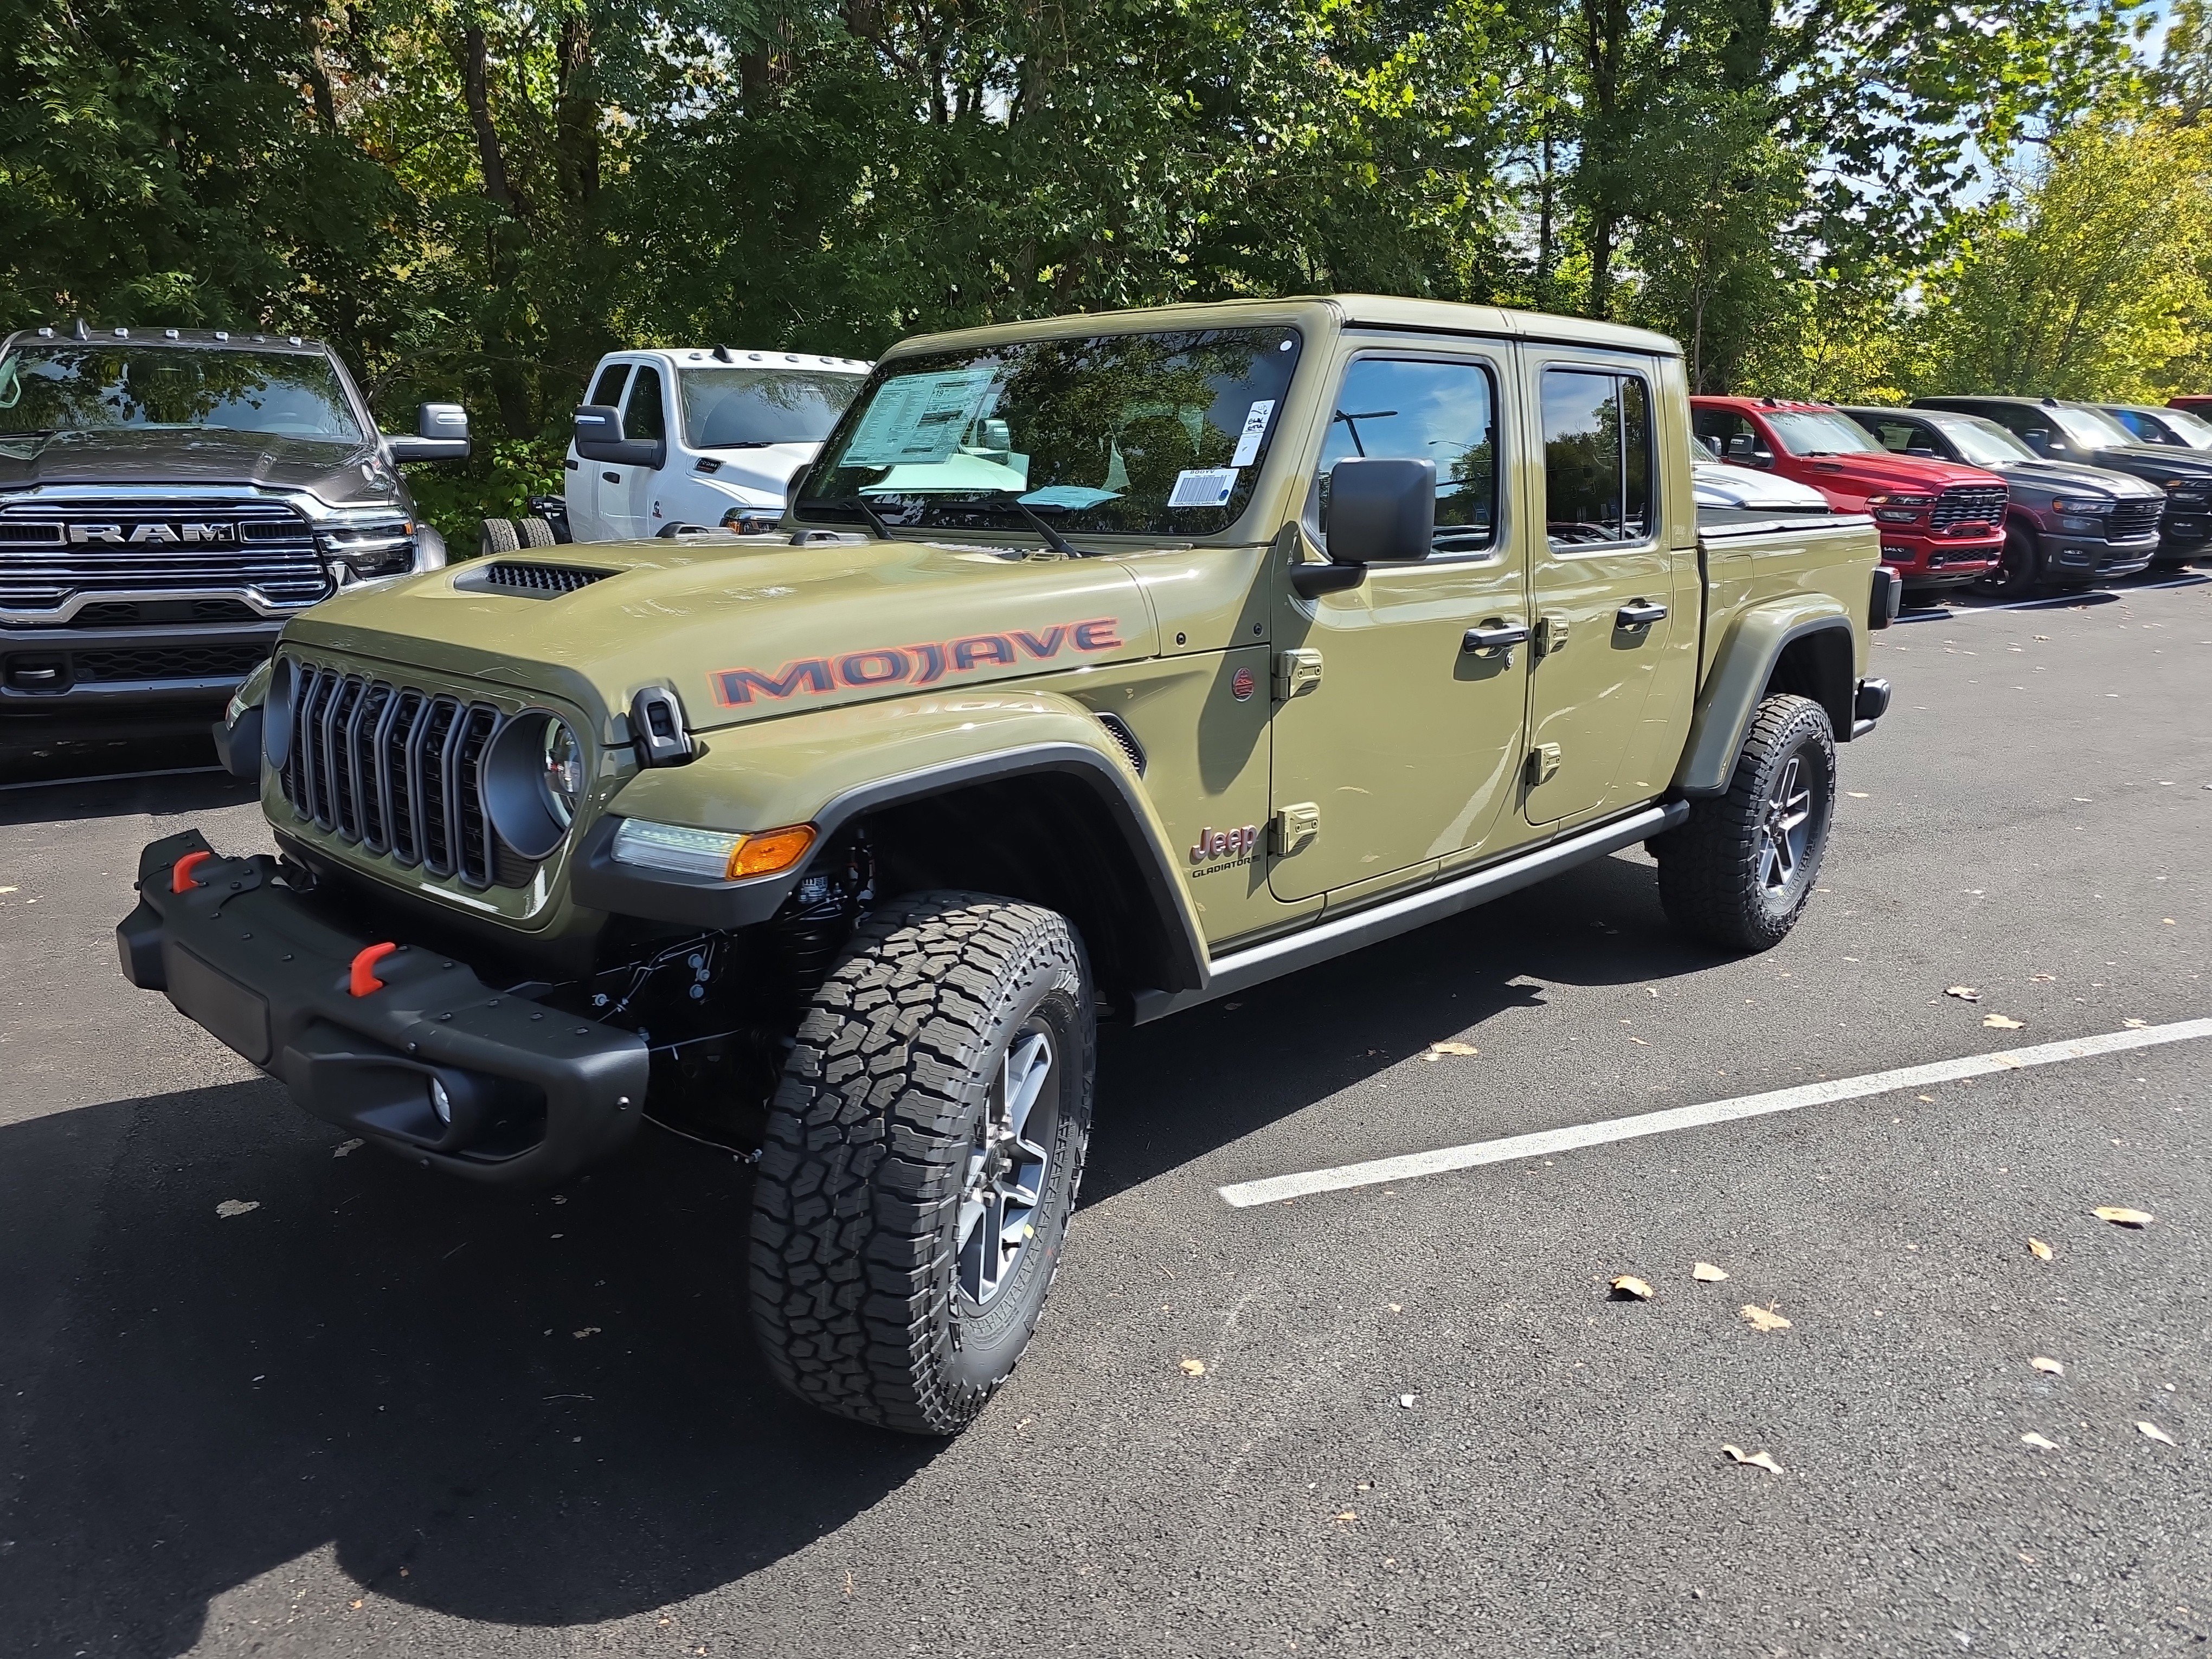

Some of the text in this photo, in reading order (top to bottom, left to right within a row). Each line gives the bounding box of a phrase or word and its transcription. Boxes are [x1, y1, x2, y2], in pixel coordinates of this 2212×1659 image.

[69, 523, 235, 543] RAM
[706, 617, 1124, 708] MOJAVE
[1191, 824, 1257, 860] Jeep
[1192, 857, 1251, 878] GLADIATOR
